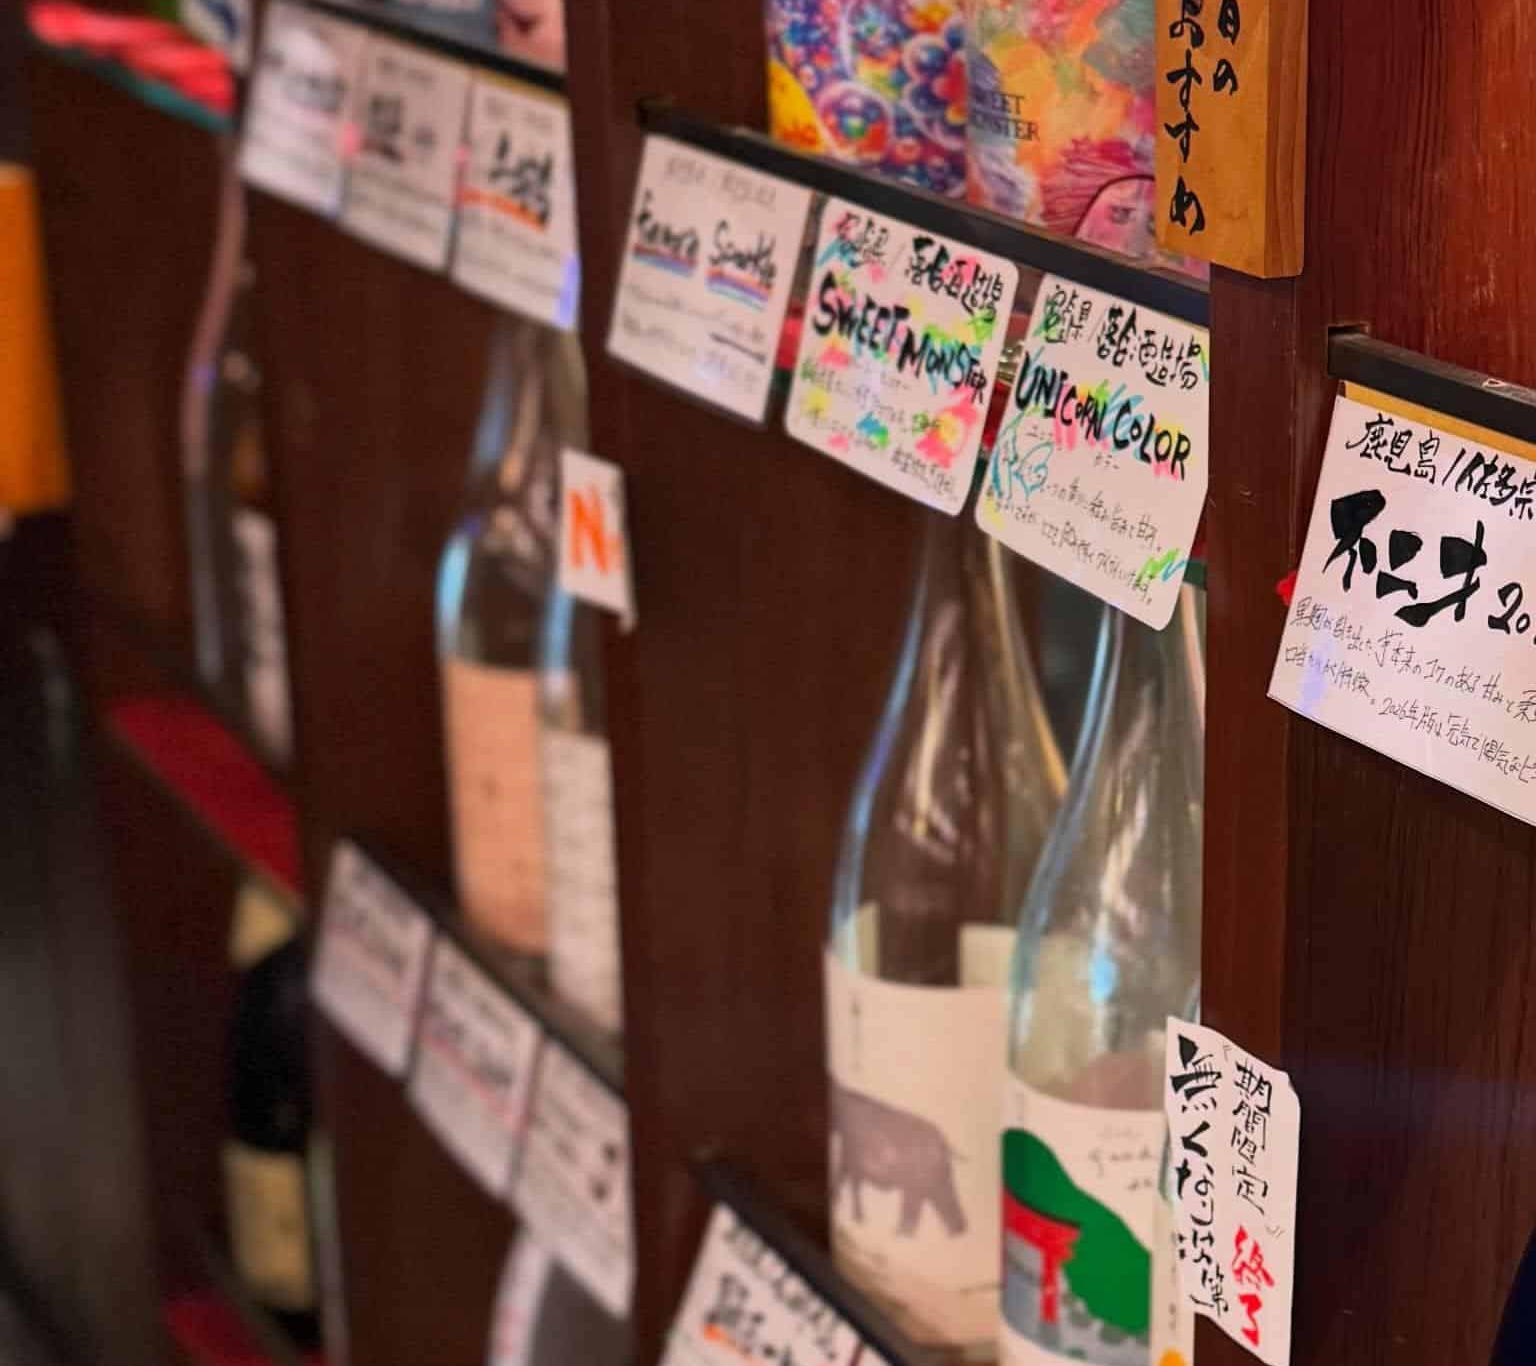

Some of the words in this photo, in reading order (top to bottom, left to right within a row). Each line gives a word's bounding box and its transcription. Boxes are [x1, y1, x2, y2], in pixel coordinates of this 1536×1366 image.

[812, 270, 909, 361] SWEET
[899, 328, 988, 407] MONSTER
[1014, 355, 1110, 445] UNICORN
[1110, 397, 1194, 484] COLOR
[1230, 1223, 1277, 1348] 終了
